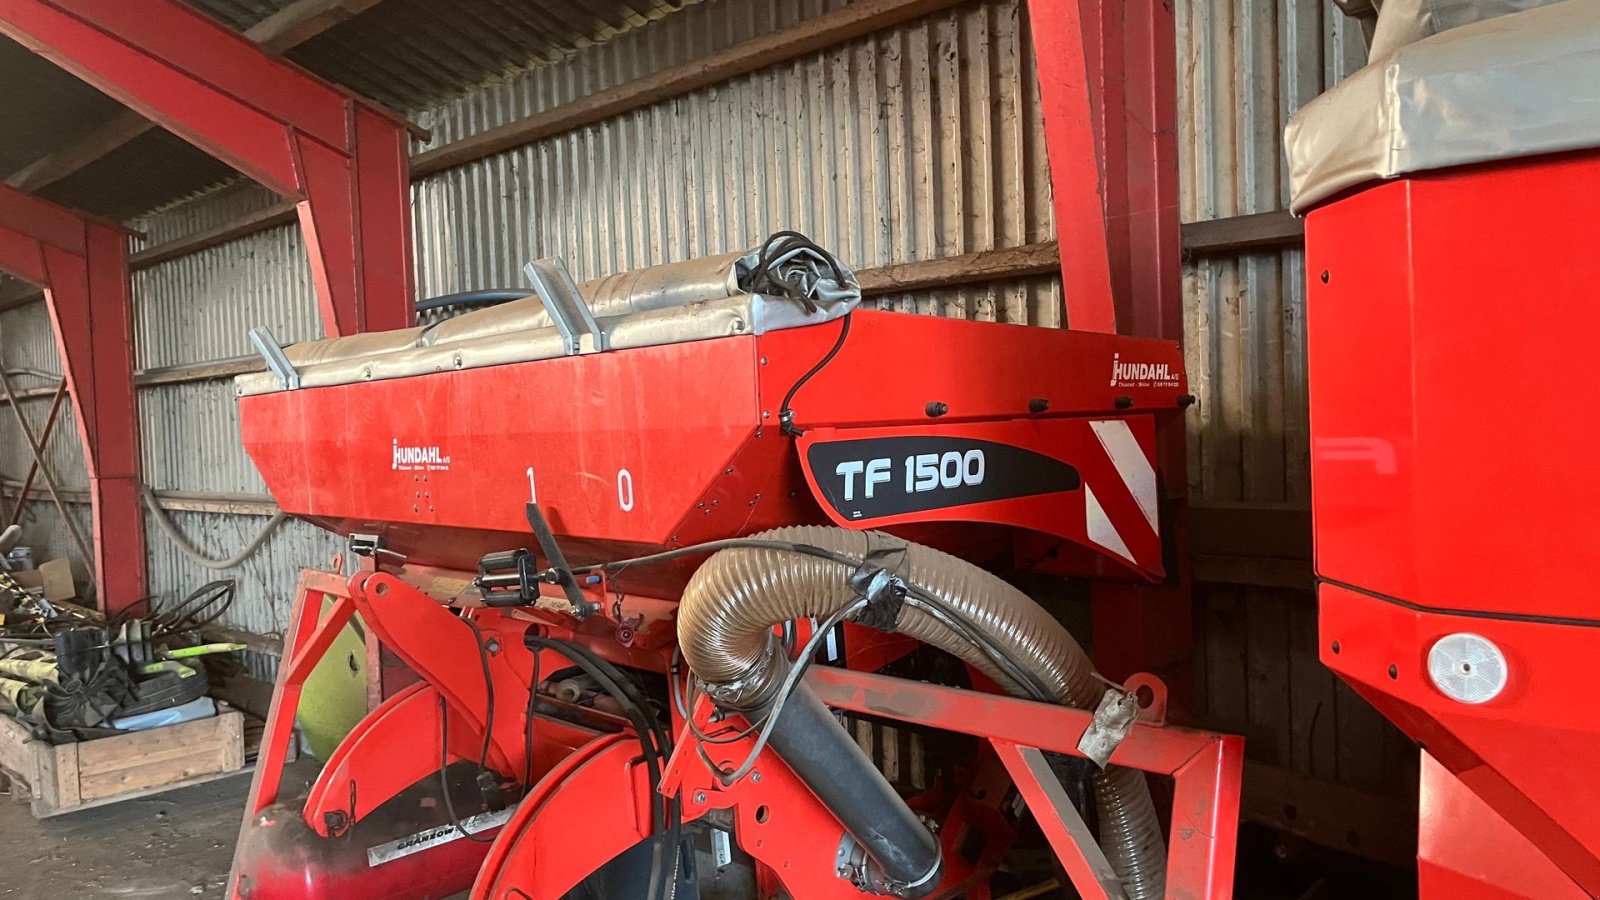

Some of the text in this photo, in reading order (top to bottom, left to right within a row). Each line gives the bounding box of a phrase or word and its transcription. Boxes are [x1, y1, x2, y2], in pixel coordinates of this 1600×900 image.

[526, 466, 634, 512] 1 0
[835, 449, 985, 501] TF 1500
